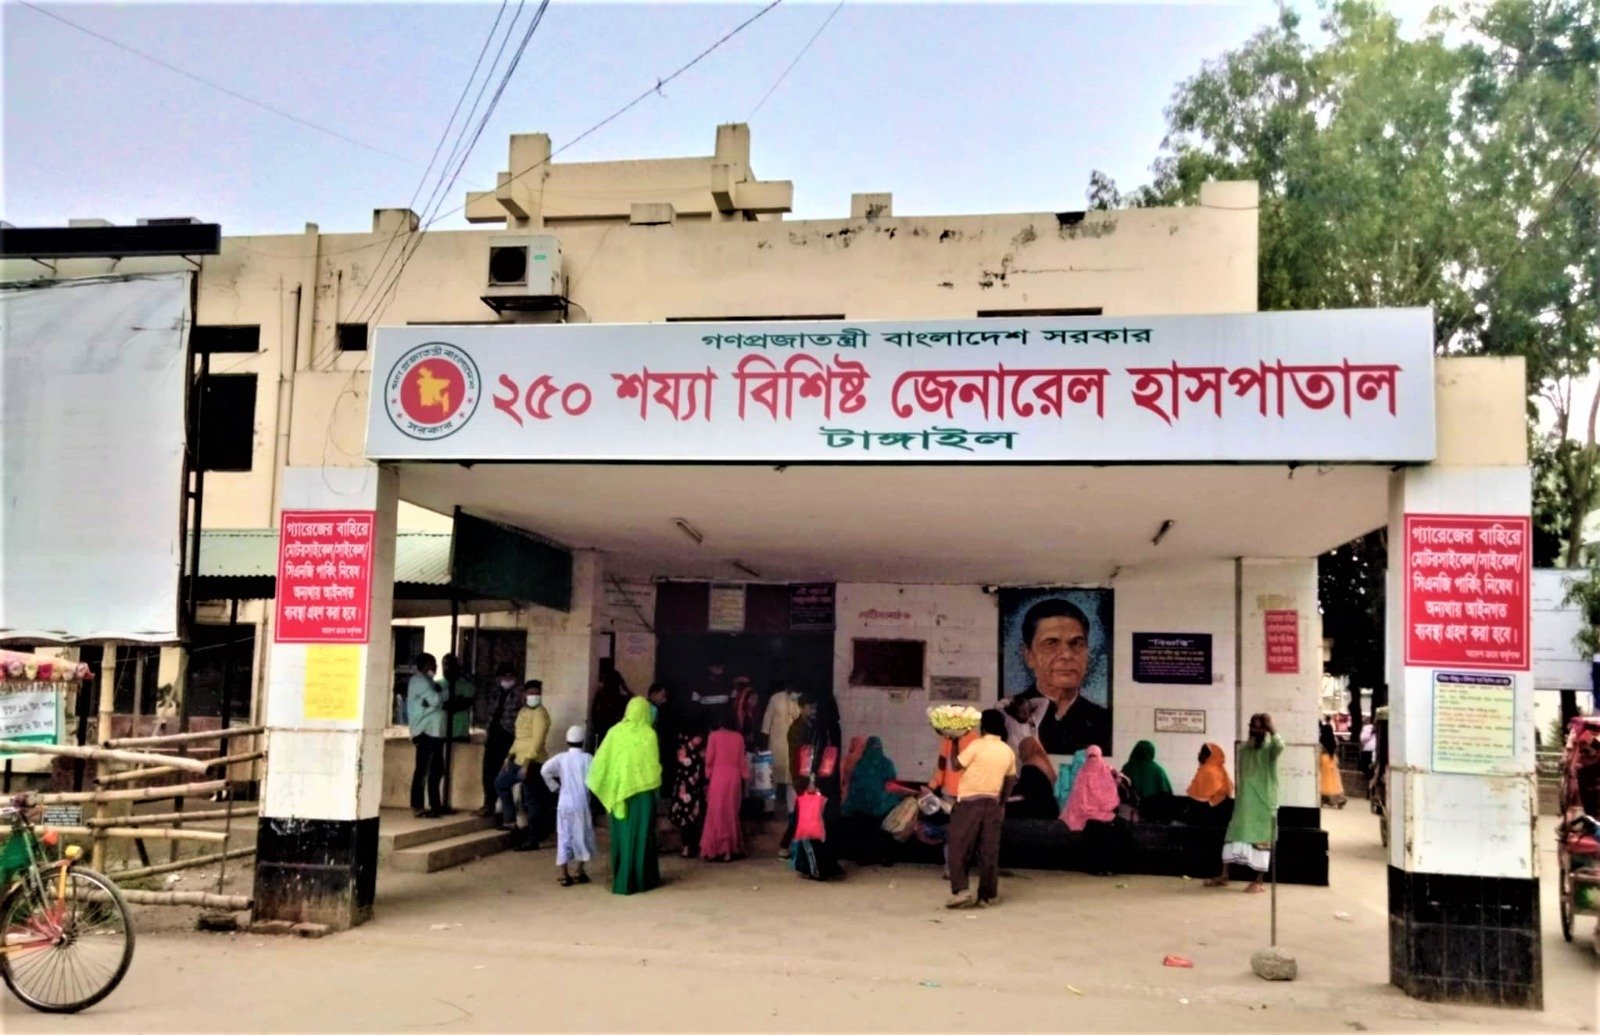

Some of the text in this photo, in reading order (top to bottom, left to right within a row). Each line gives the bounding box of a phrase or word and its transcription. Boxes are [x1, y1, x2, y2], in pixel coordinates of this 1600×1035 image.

[702, 327, 1152, 349] গণপ্রজাতন্ত্রী বাংলাদেশ সরকার
[493, 353, 1400, 425] ২৫০ শয্যা বিশিষ্ট জেনারেল হাসপাতাল
[408, 421, 453, 435] সরকার
[820, 426, 1017, 451] টাঙ্গাইল
[286, 518, 369, 538] গ্যারেজের বাহিরে
[1412, 523, 1522, 549] গ্যারেজের বাহিরে
[1413, 571, 1452, 594] সিএনজি
[1470, 624, 1489, 644] করা
